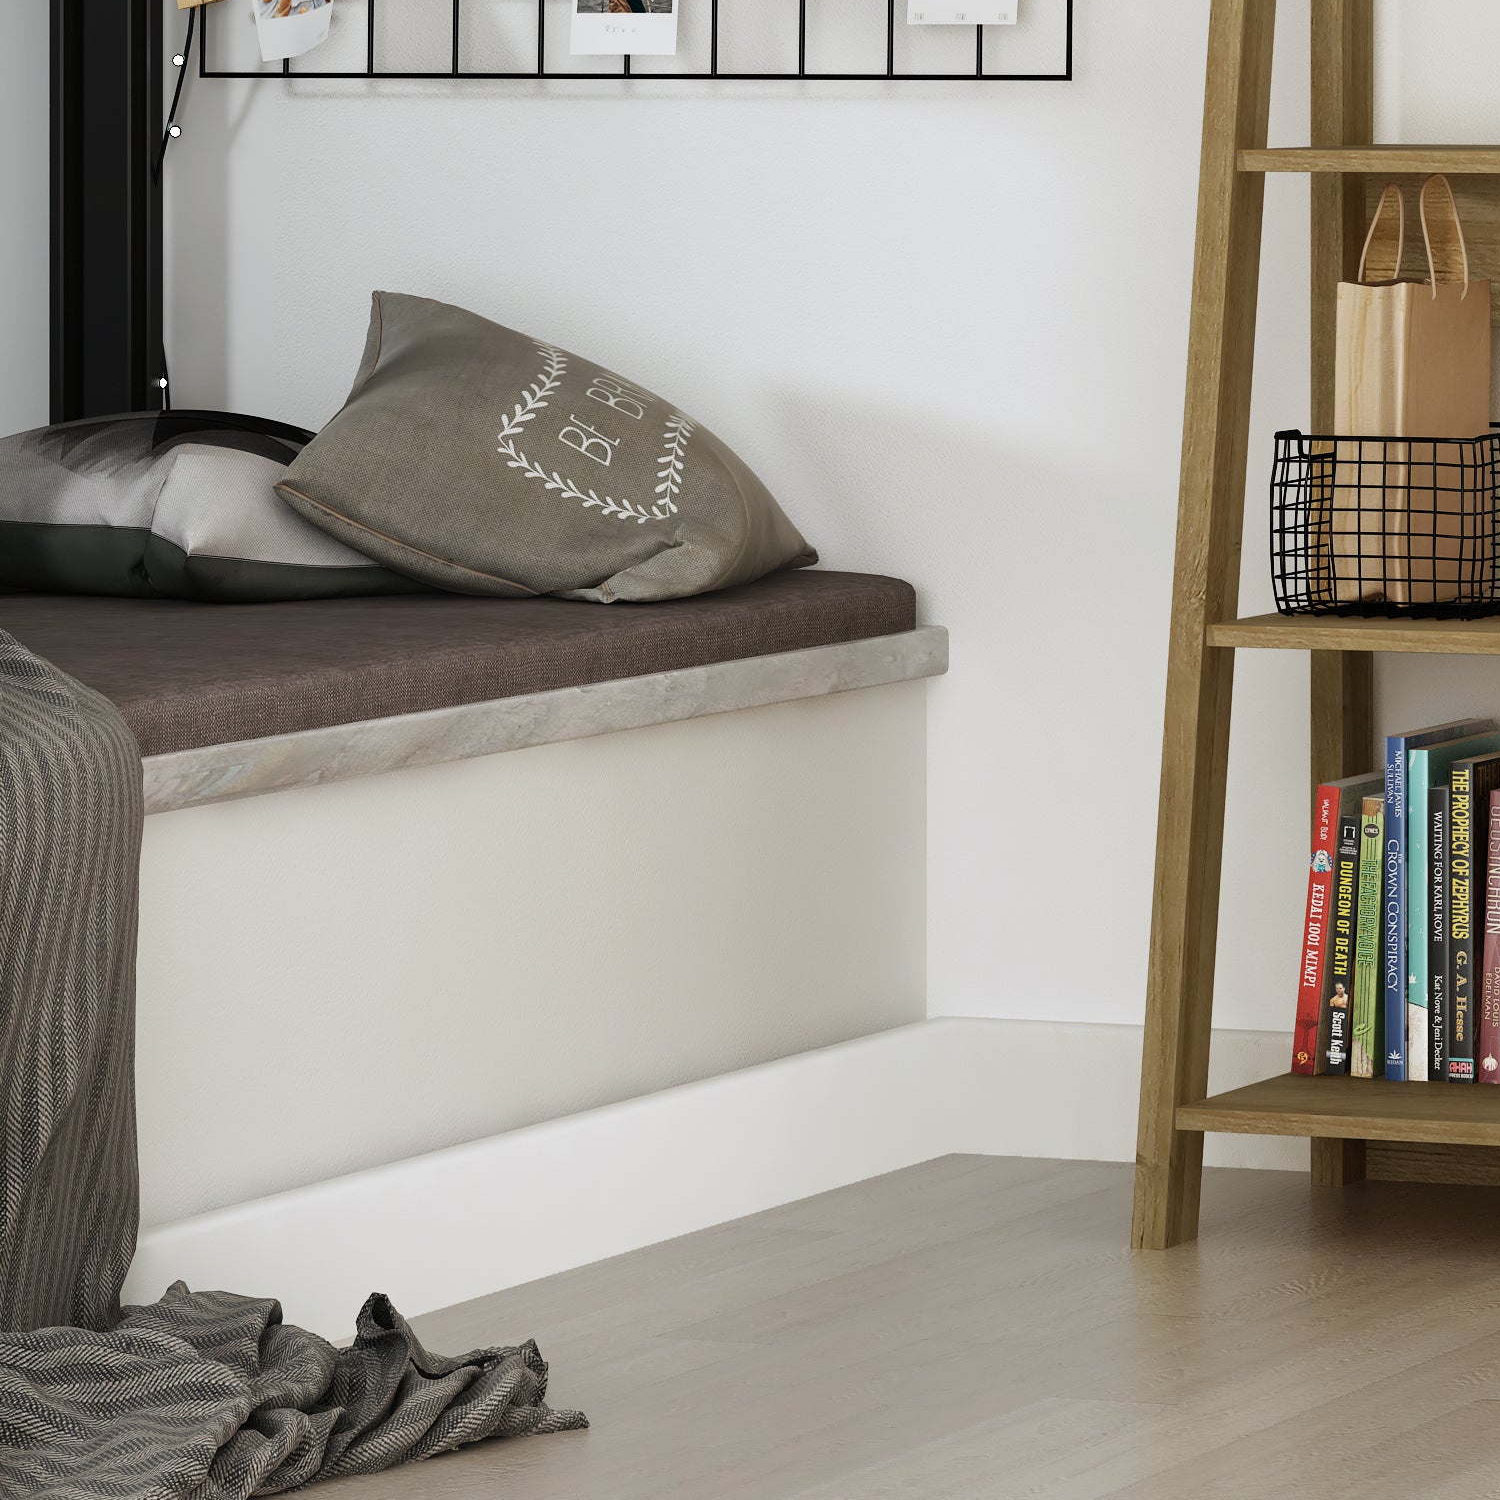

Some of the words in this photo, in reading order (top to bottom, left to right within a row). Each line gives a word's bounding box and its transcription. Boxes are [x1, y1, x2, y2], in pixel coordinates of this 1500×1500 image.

[1394, 750, 1404, 790] MICHAEL
[1452, 769, 1469, 793] THE
[1394, 792, 1404, 818] JAMES
[1434, 811, 1443, 859] WAITING
[1451, 794, 1470, 858] PROPHECY
[1361, 859, 1378, 880] THE
[1387, 840, 1400, 898] CROWN
[1434, 861, 1443, 883] FOR
[1451, 860, 1470, 876] OF
[1310, 883, 1325, 920] KEDAI
[1337, 861, 1354, 918] DUNGEON
[1434, 886, 1443, 914] KARL
[1358, 880, 1378, 934] FACTORY
[1452, 878, 1470, 940] ZEPHYRUS
[1307, 922, 1322, 947] 1001
[1336, 920, 1350, 935] OF
[1433, 916, 1442, 942] ROVE
[1334, 938, 1349, 976] DEATH
[1357, 934, 1375, 967] VOICE
[1387, 903, 1399, 992] CONSPIRACY
[1456, 950, 1468, 970] G.
[1304, 948, 1318, 988] MIMPI
[1434, 974, 1443, 990] Kat
[1456, 974, 1468, 992] A.
[1484, 972, 1492, 1020] EDELMAN
[1434, 992, 1442, 1014] Nove
[1492, 998, 1500, 1028] LOUIS
[1332, 1011, 1346, 1038] Scott
[1432, 1024, 1442, 1040] Jeni
[1434, 1016, 1442, 1024] &
[1456, 996, 1468, 1042] Hesse
[1330, 1038, 1344, 1065] Keith
[1434, 1042, 1442, 1070] Decker
